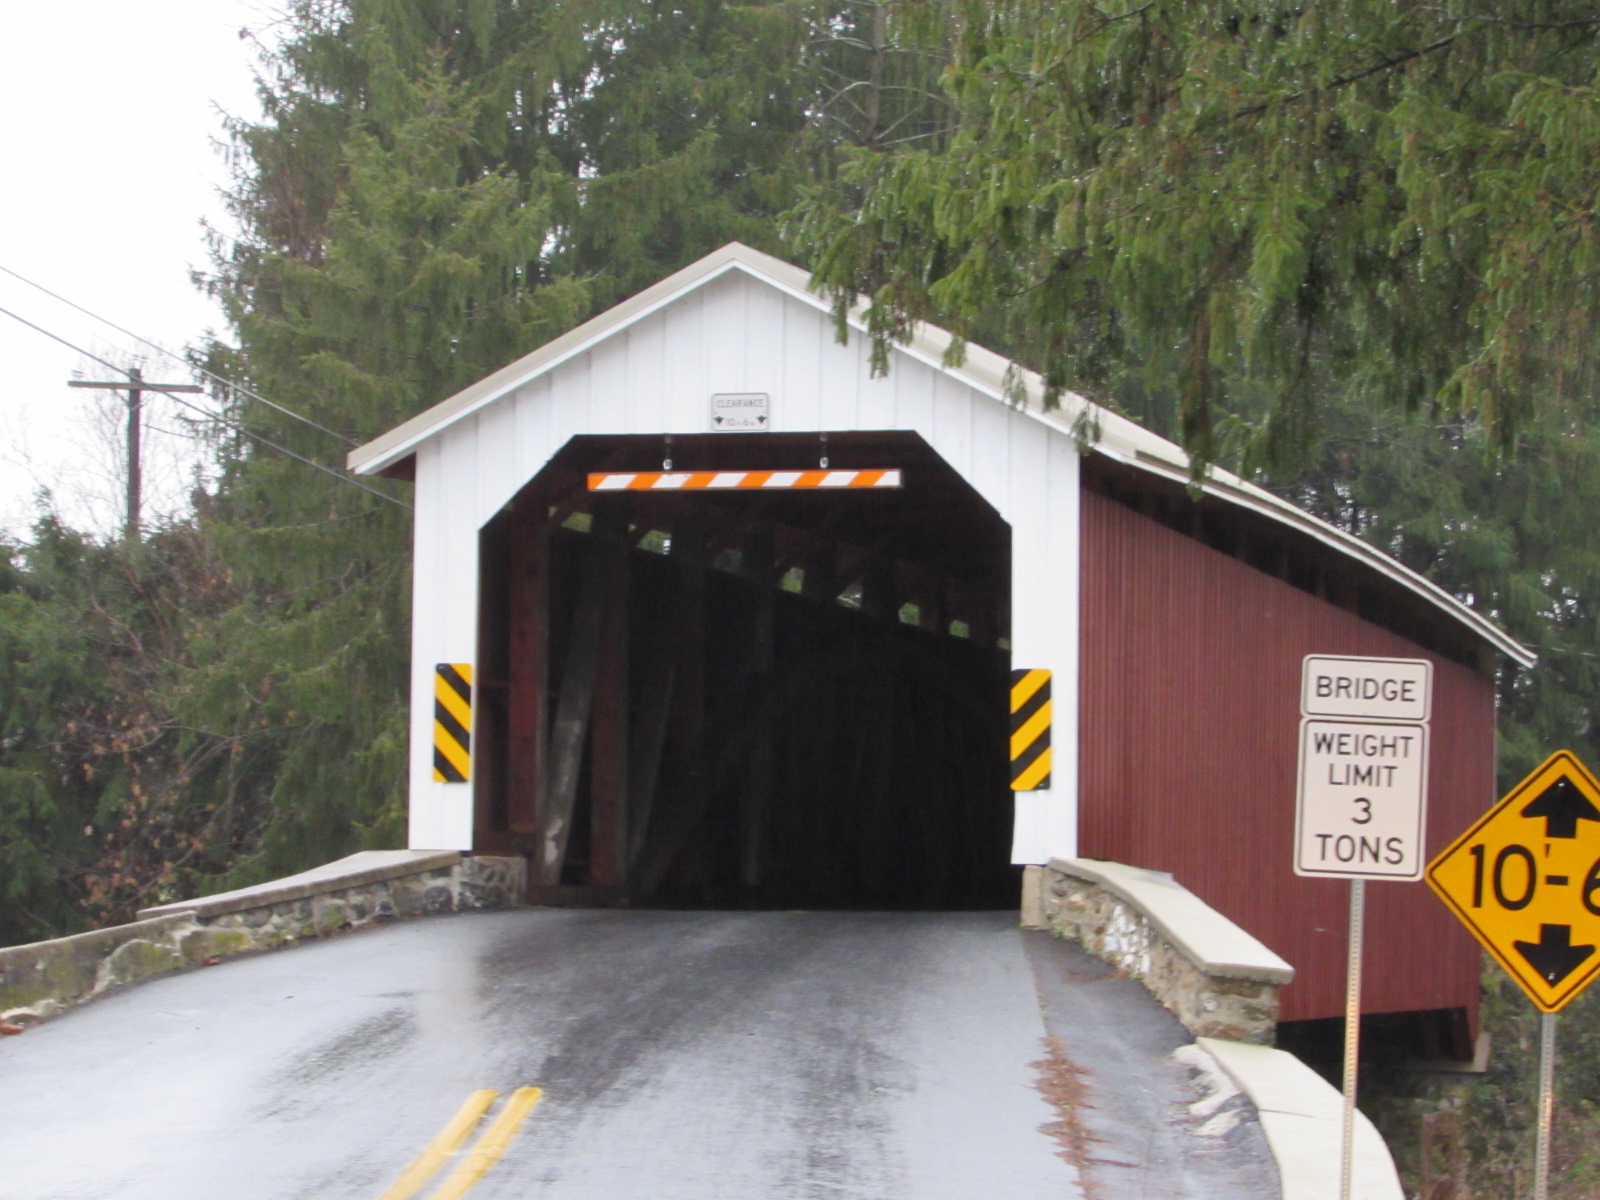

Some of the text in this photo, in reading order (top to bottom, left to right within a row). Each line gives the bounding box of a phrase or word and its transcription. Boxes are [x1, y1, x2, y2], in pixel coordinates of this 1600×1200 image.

[715, 399, 765, 408] CLEARANCE
[1316, 675, 1417, 702] BRIDGE
[1314, 732, 1414, 758] WEIGHT
[1328, 763, 1398, 788] LIMIT
[1351, 797, 1372, 824] 3
[1315, 834, 1404, 865] TONS
